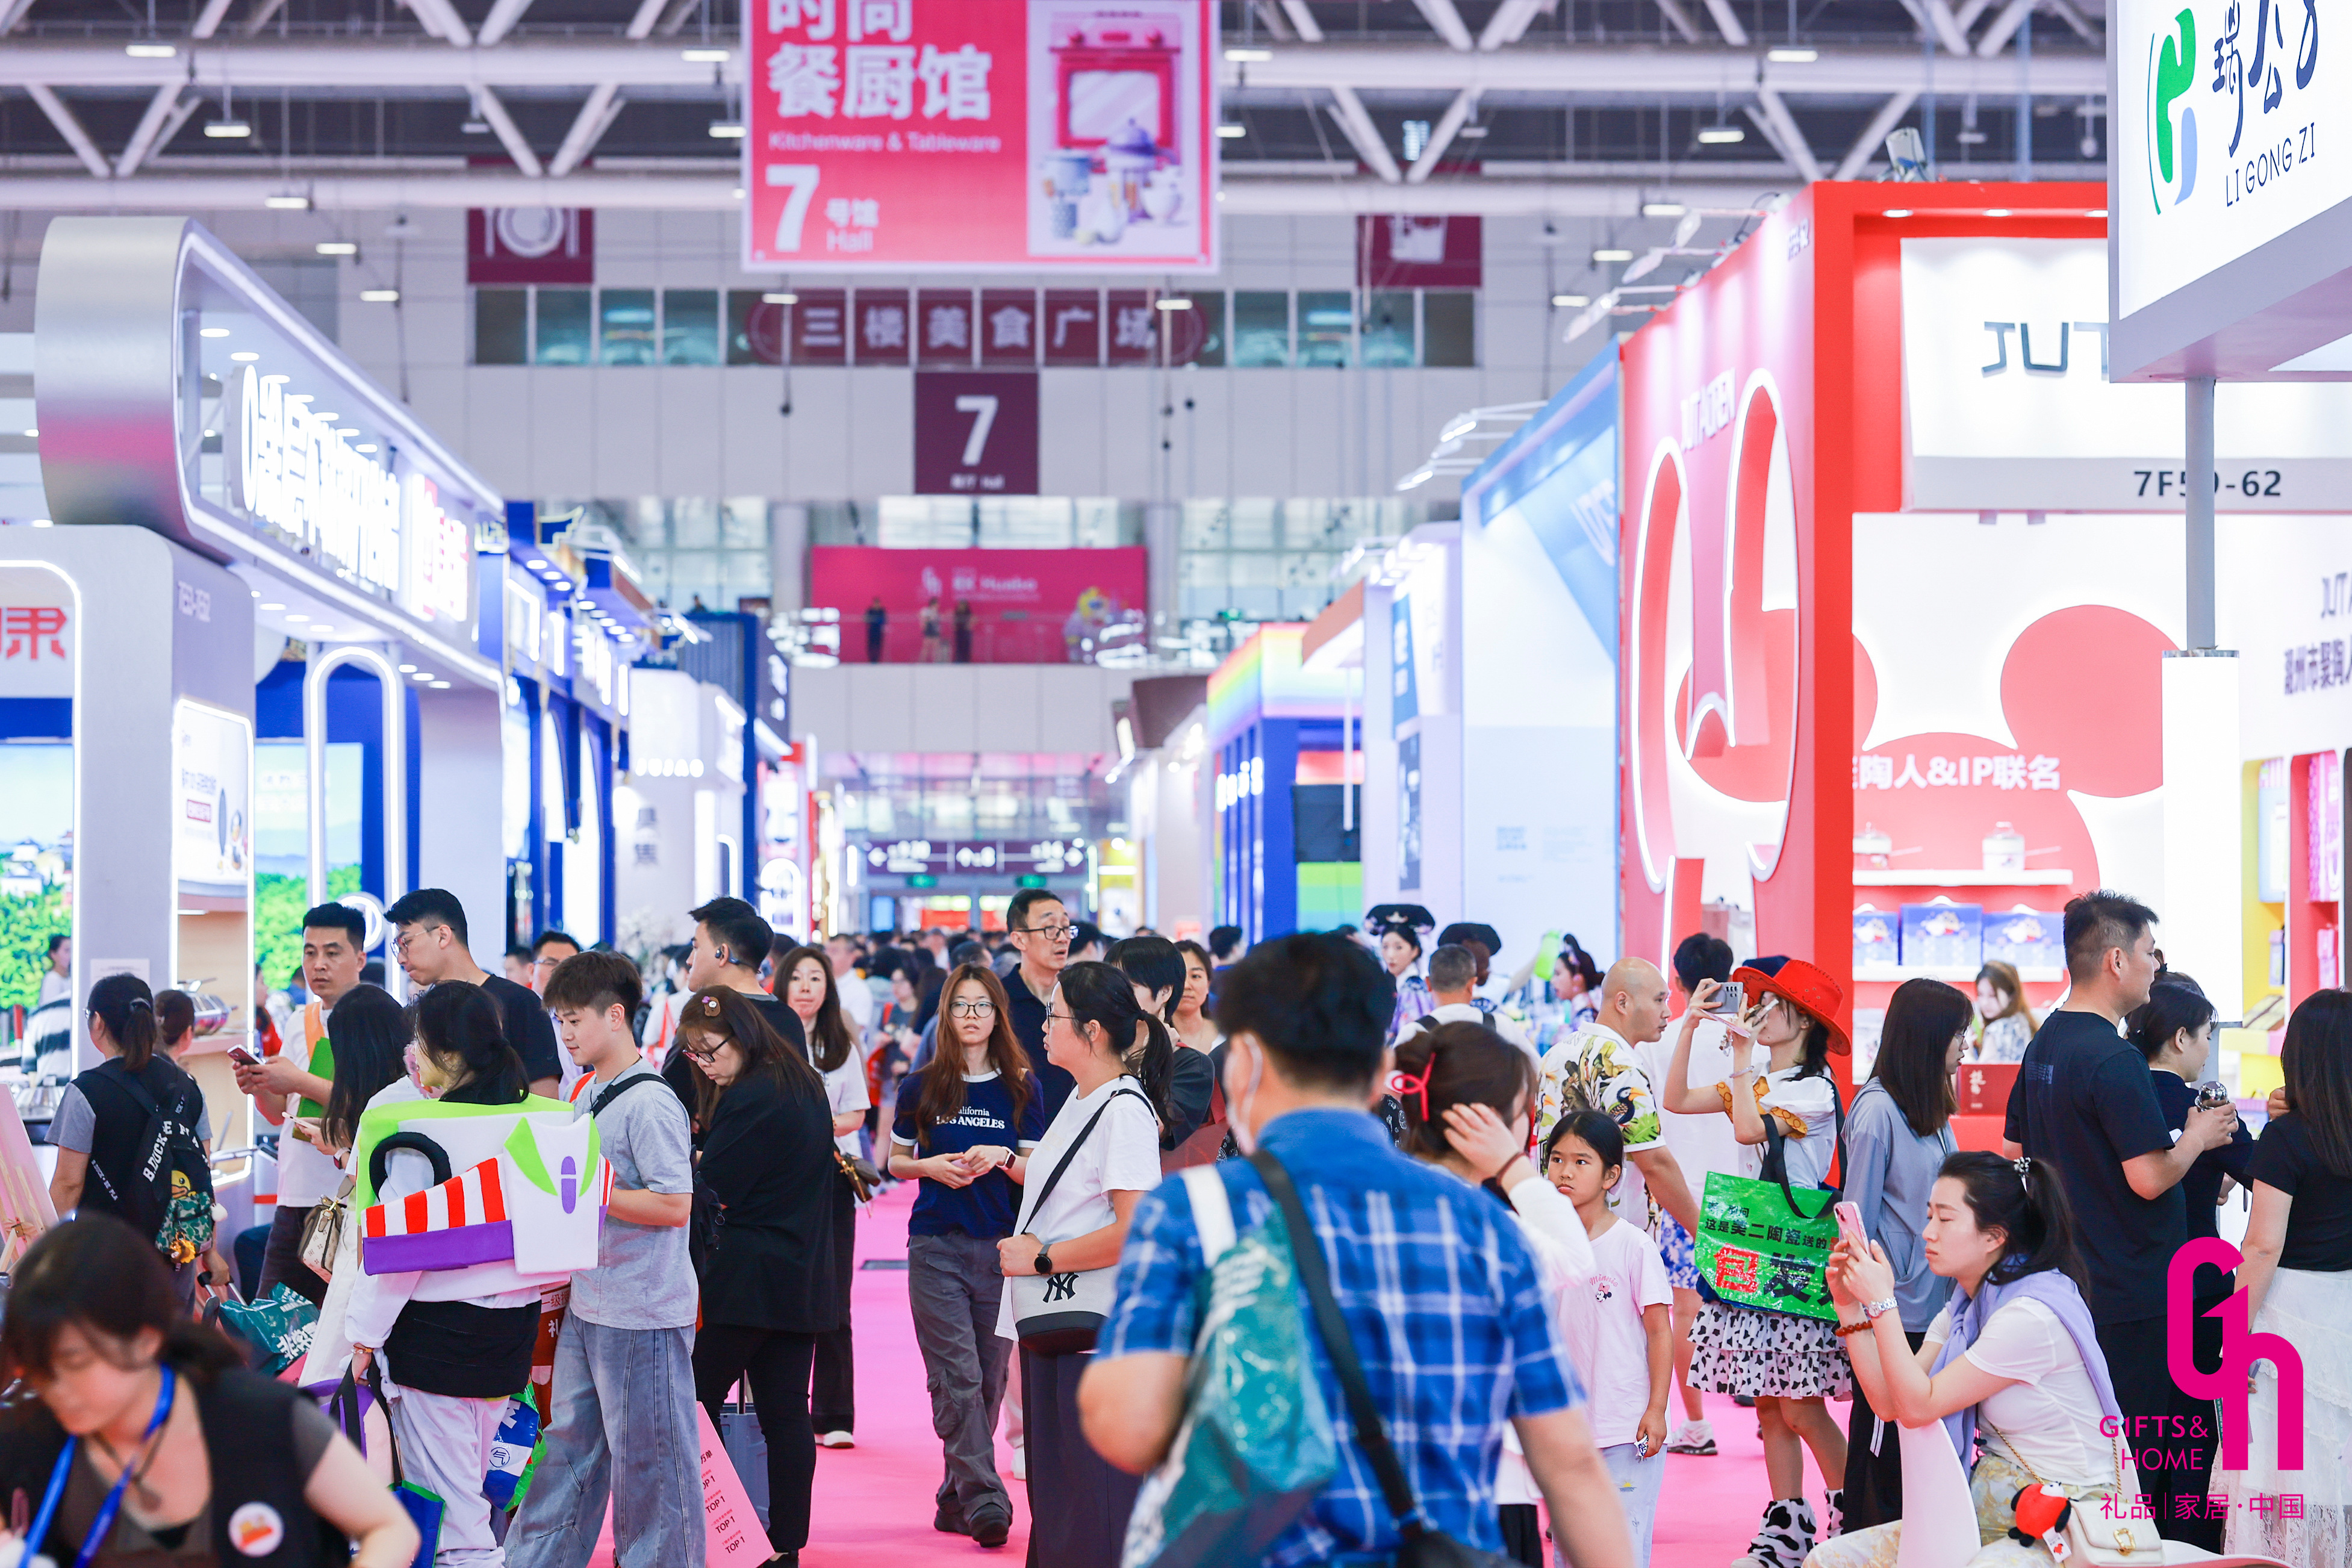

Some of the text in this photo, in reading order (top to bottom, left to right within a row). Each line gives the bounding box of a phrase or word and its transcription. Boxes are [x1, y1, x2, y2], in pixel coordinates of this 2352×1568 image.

[768, 43, 992, 120] 餐厨馆
[768, 132, 1001, 152] Kitchenware & Tableware
[2226, 122, 2315, 207] LI GONG ZI
[765, 164, 820, 252] 7
[827, 198, 880, 228] 号馆
[826, 228, 873, 252] Hall
[956, 395, 999, 466] 7
[1852, 754, 2061, 791] 陶人&IP联名
[957, 1116, 1005, 1130] ANGELES
[705, 1499, 720, 1513] TOP
[715, 1519, 730, 1534] TOP
[724, 1539, 739, 1554] TOP
